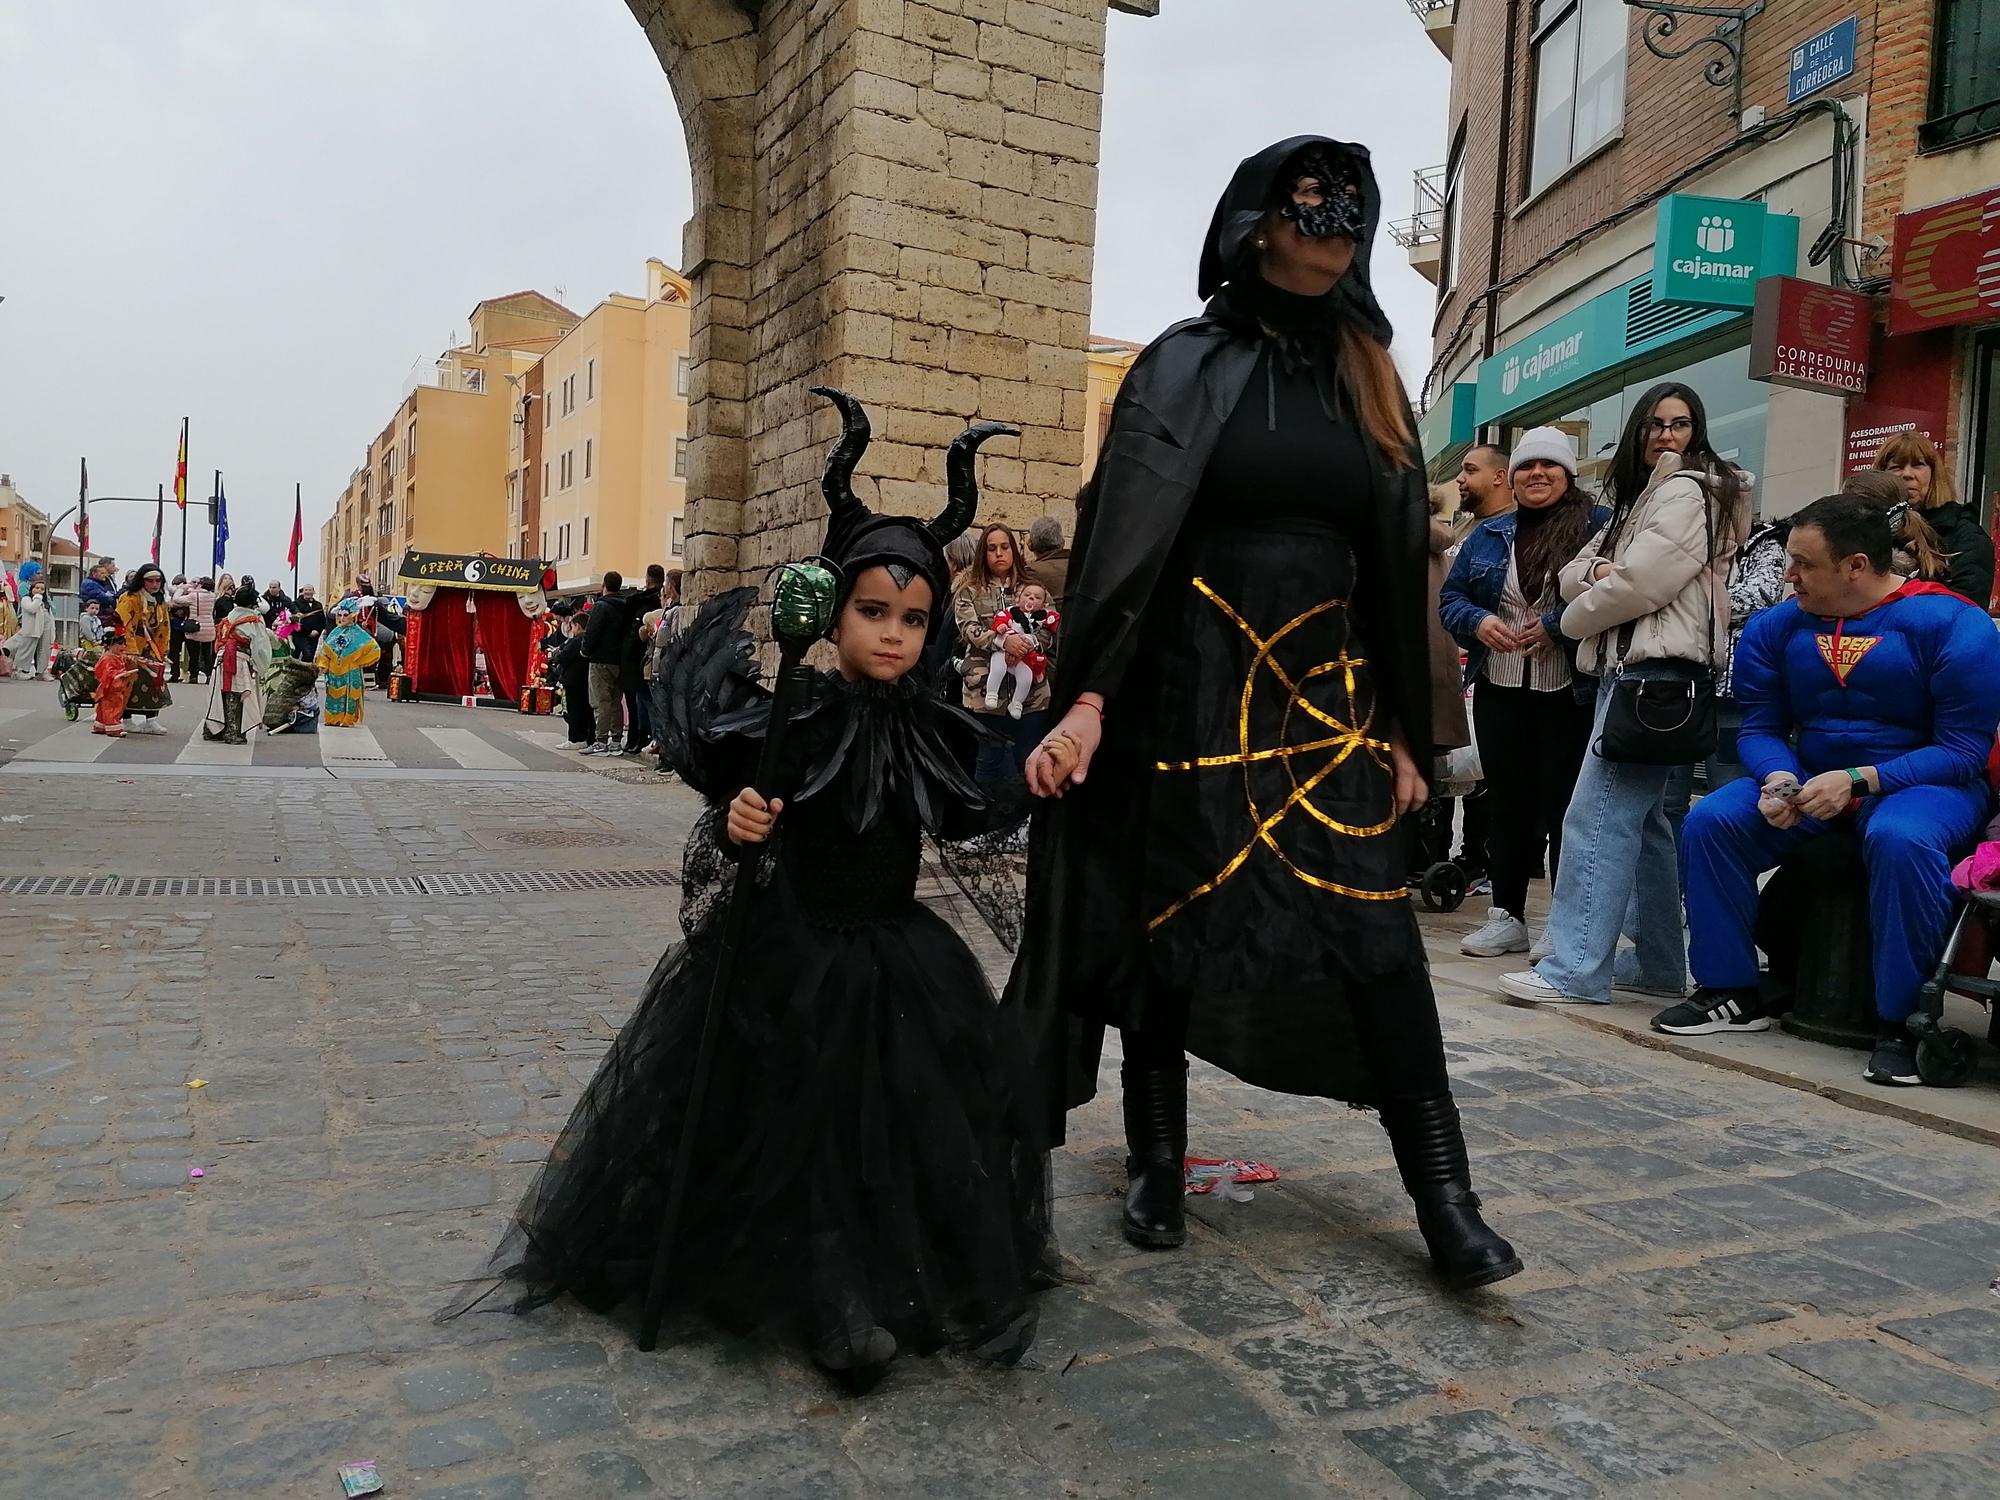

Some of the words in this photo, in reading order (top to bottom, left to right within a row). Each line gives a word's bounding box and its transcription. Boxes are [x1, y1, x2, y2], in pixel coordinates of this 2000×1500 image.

[1810, 32, 1834, 57] CALLE
[1809, 57, 1820, 69] DE
[1823, 51, 1833, 61] LA
[1795, 56, 1844, 95] CORREDERA
[1672, 255, 1754, 280] cajamar
[1522, 330, 1583, 382] cajamar
[1777, 345, 1865, 375] CORREDURIA
[1779, 361, 1795, 376] DE
[1850, 422, 1916, 439] ASESORAMIENTO
[1850, 441, 1855, 449] Y
[1849, 452, 1859, 460] EN
[1851, 464, 1874, 472] -AUTO
[420, 560, 464, 575] OPERA
[489, 563, 530, 581] CHINA
